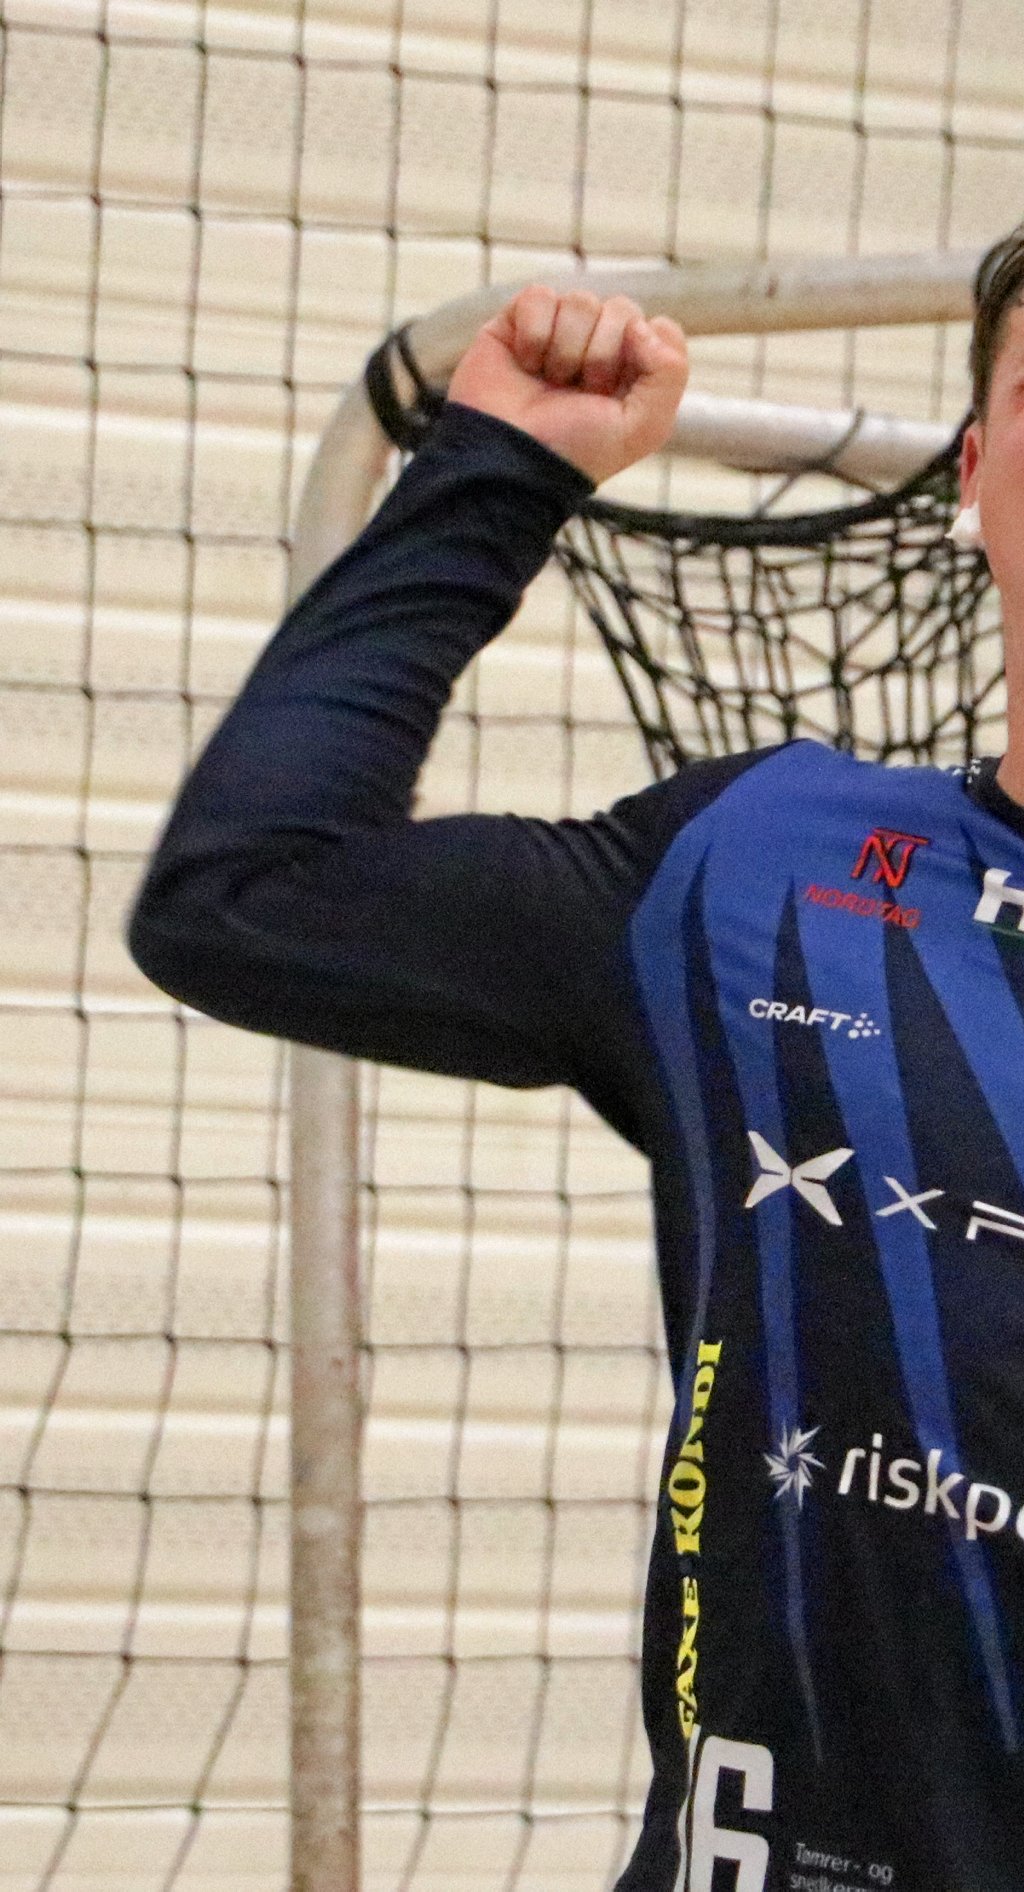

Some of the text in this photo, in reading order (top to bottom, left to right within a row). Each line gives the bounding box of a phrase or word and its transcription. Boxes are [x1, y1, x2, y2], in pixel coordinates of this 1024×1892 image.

[804, 883, 922, 930] NORDTAG
[748, 998, 851, 1032] CRAFT
[667, 1339, 724, 1556] KONDI
[672, 1721, 774, 1892] 6
[868, 1863, 893, 1886] og
